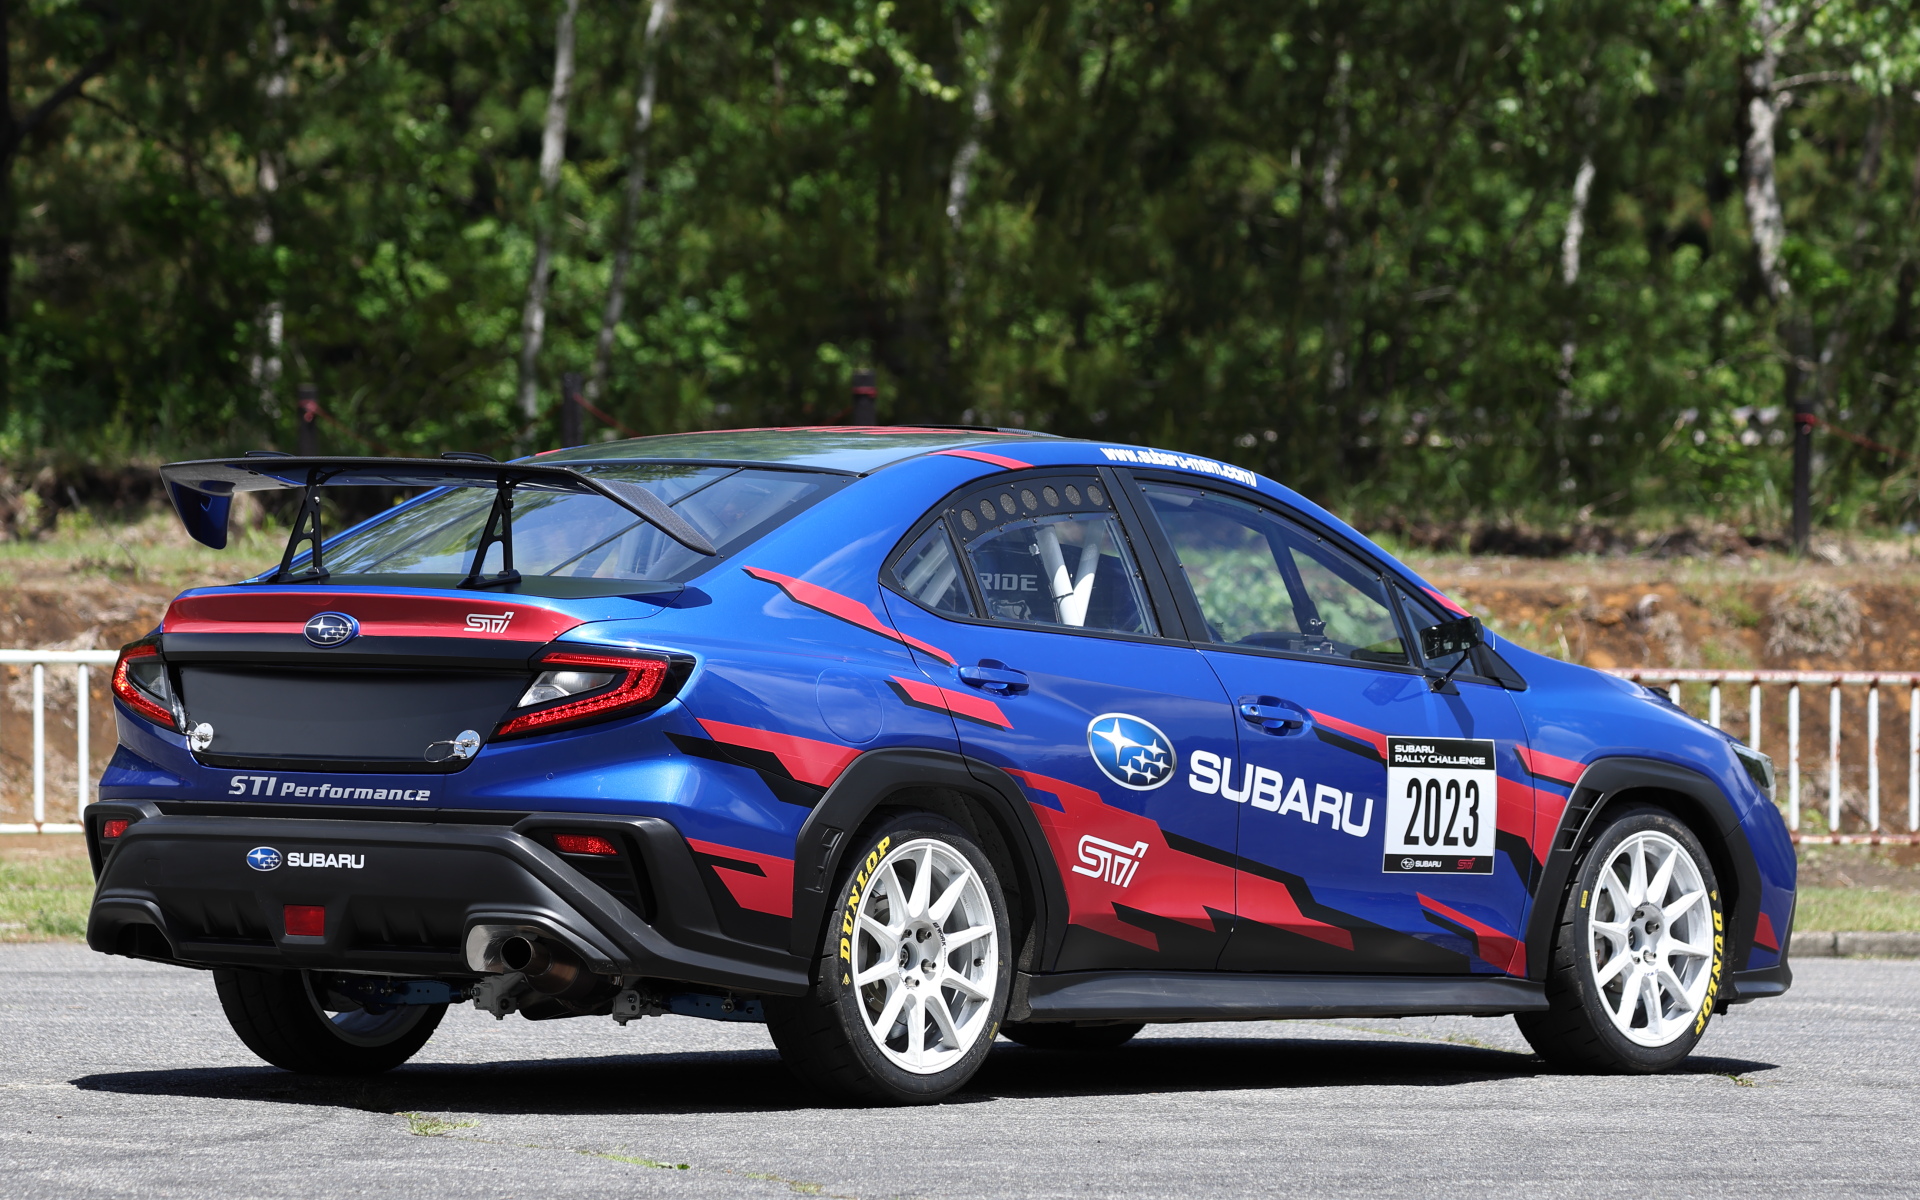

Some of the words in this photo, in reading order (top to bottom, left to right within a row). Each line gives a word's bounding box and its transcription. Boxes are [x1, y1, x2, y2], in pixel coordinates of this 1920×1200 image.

[1394, 744, 1435, 753] SUBARU
[1394, 754, 1426, 763] RALLY
[1428, 755, 1486, 765] CHALLENGE
[228, 775, 277, 796] STI
[280, 782, 431, 801] Performance
[1189, 750, 1374, 838] SUBARU
[1403, 777, 1480, 848] 2023
[287, 852, 365, 869] SUBARU
[1415, 860, 1442, 868] SUBARU
[840, 836, 891, 964] DUNLOP
[1695, 910, 1724, 1035] DUNLOP
